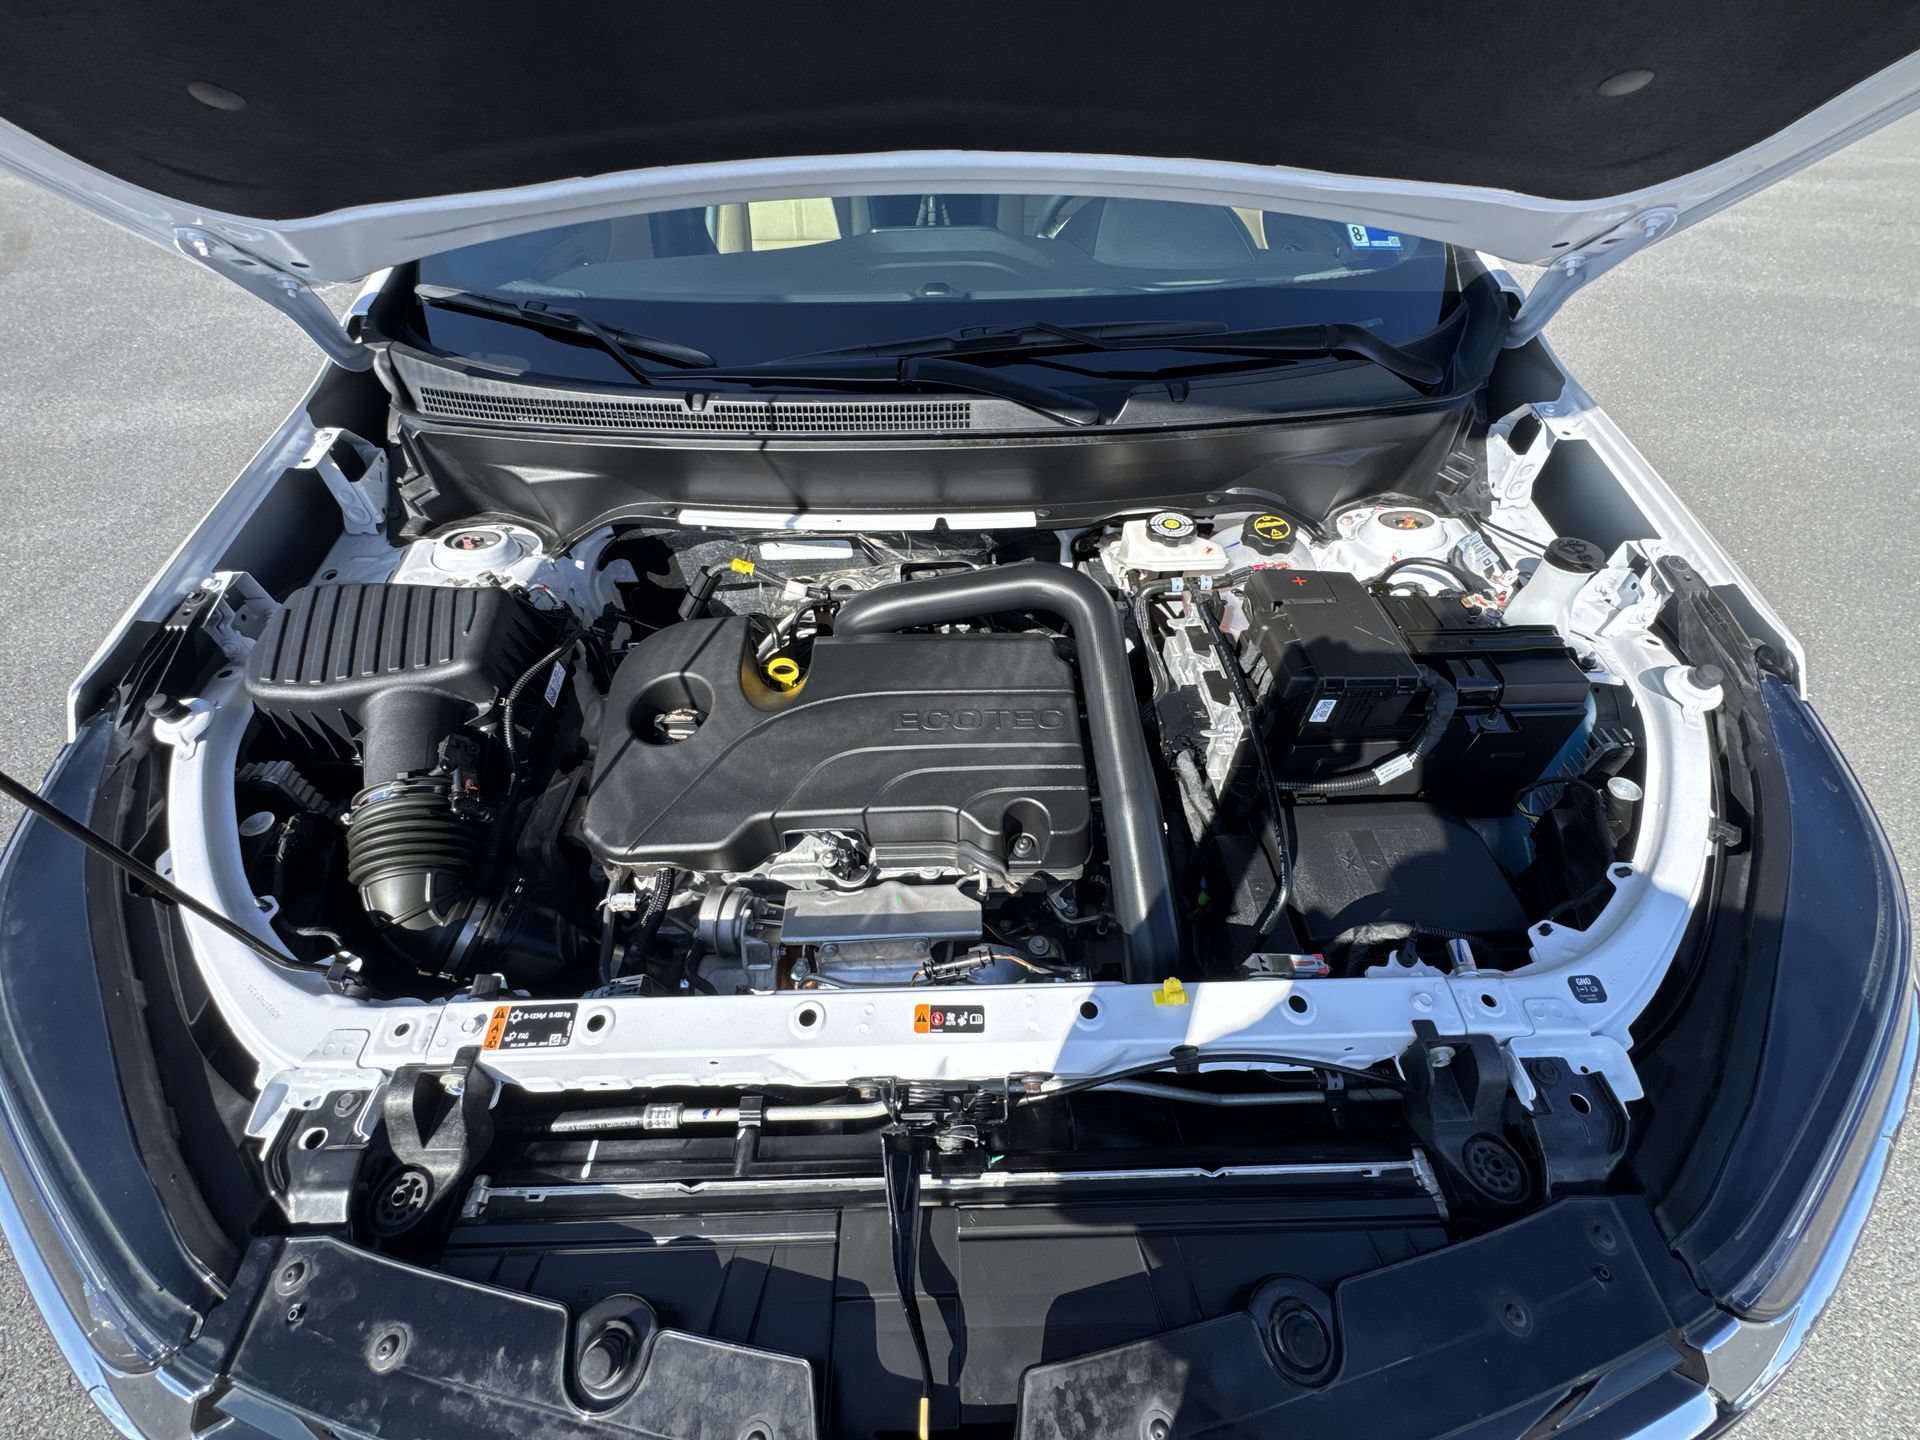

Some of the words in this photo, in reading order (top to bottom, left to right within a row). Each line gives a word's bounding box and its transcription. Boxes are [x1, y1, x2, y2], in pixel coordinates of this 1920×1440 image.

[1351, 226, 1363, 241] 8
[894, 708, 1066, 731] ECOTEC
[1575, 977, 1592, 986] GND
[517, 1032, 530, 1040] PAG
